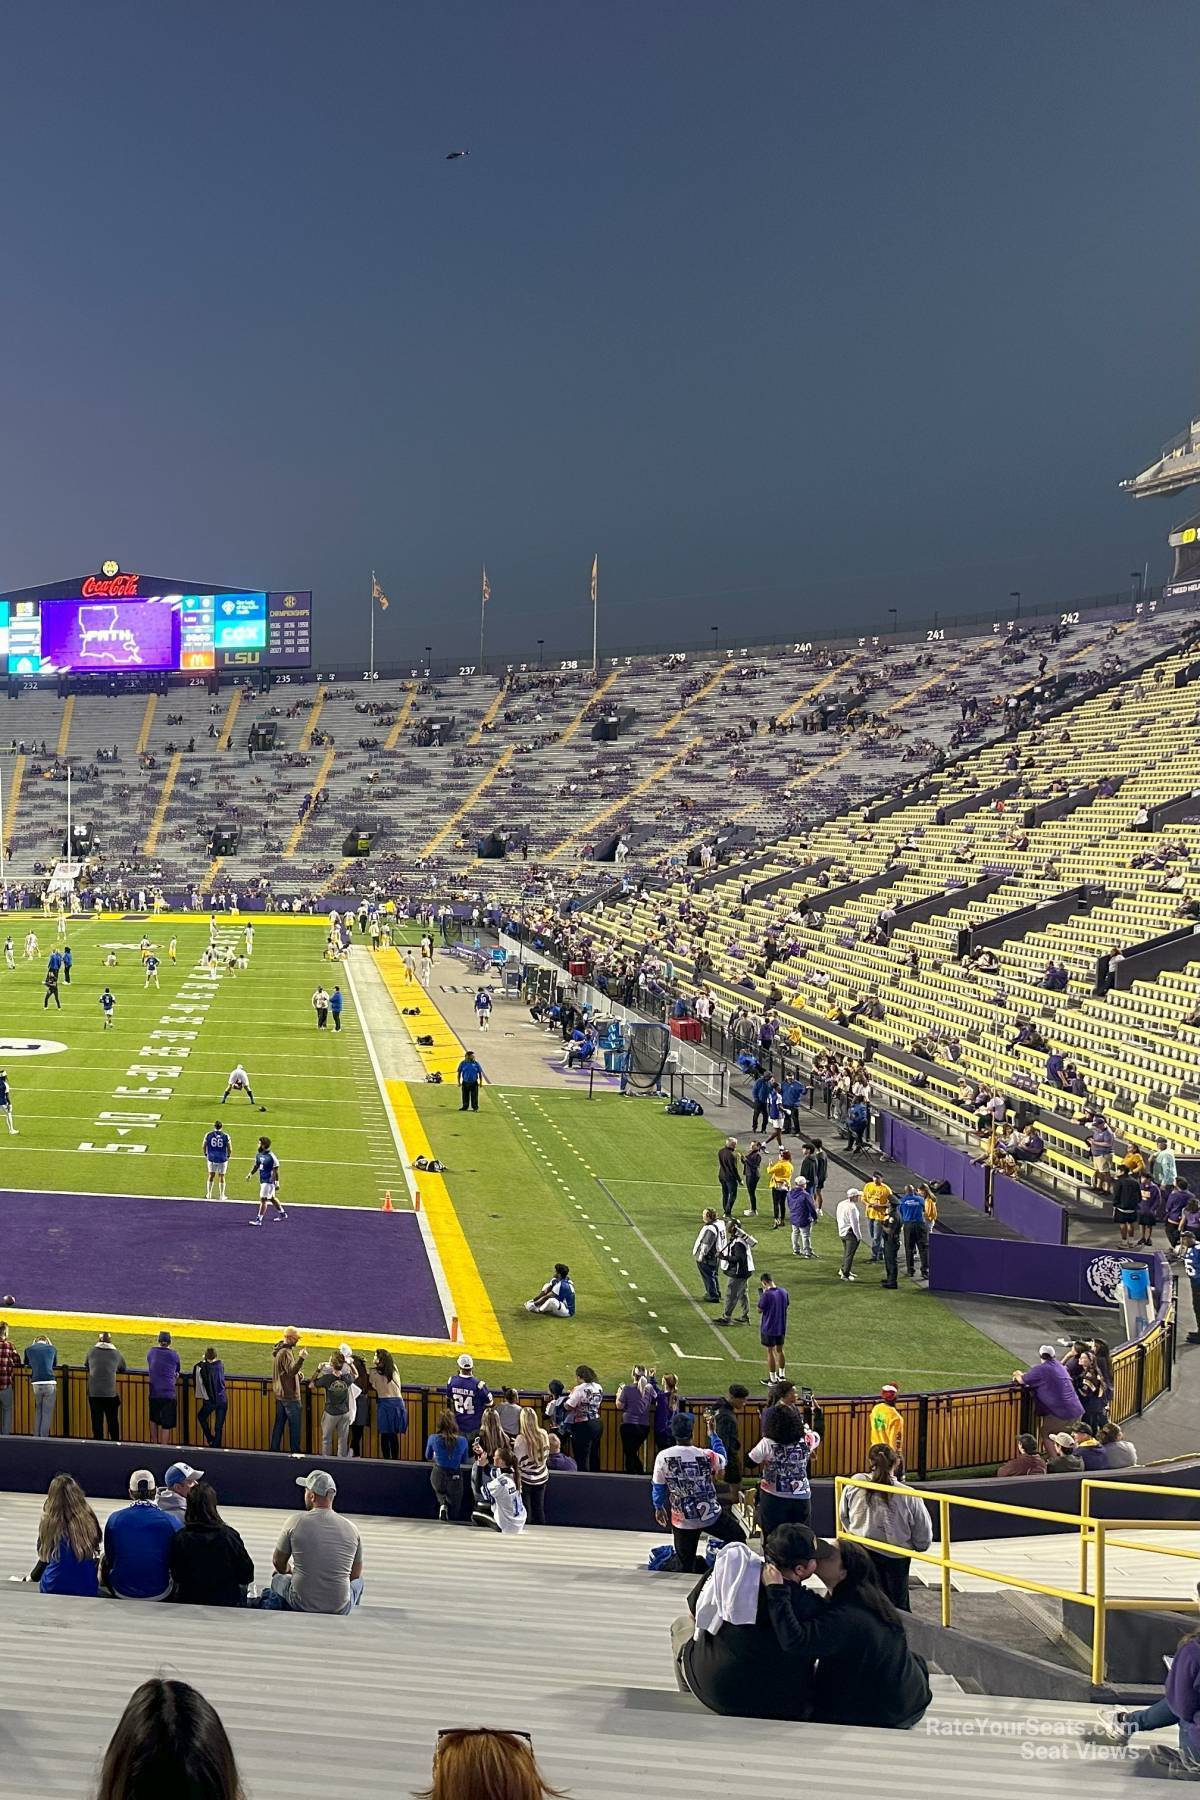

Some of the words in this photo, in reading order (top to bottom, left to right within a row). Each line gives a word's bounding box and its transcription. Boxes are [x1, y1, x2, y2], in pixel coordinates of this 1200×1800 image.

[1060, 612, 1080, 624] 242
[926, 629, 945, 641] 241
[793, 642, 812, 653] 240
[224, 651, 260, 665] LSU
[560, 660, 578, 670] 238
[459, 666, 475, 676] 237
[189, 678, 205, 686] 234
[275, 675, 291, 683] 235
[23, 681, 39, 690] 232
[210, 1137, 224, 1148] 66
[452, 1393, 475, 1415] 24
